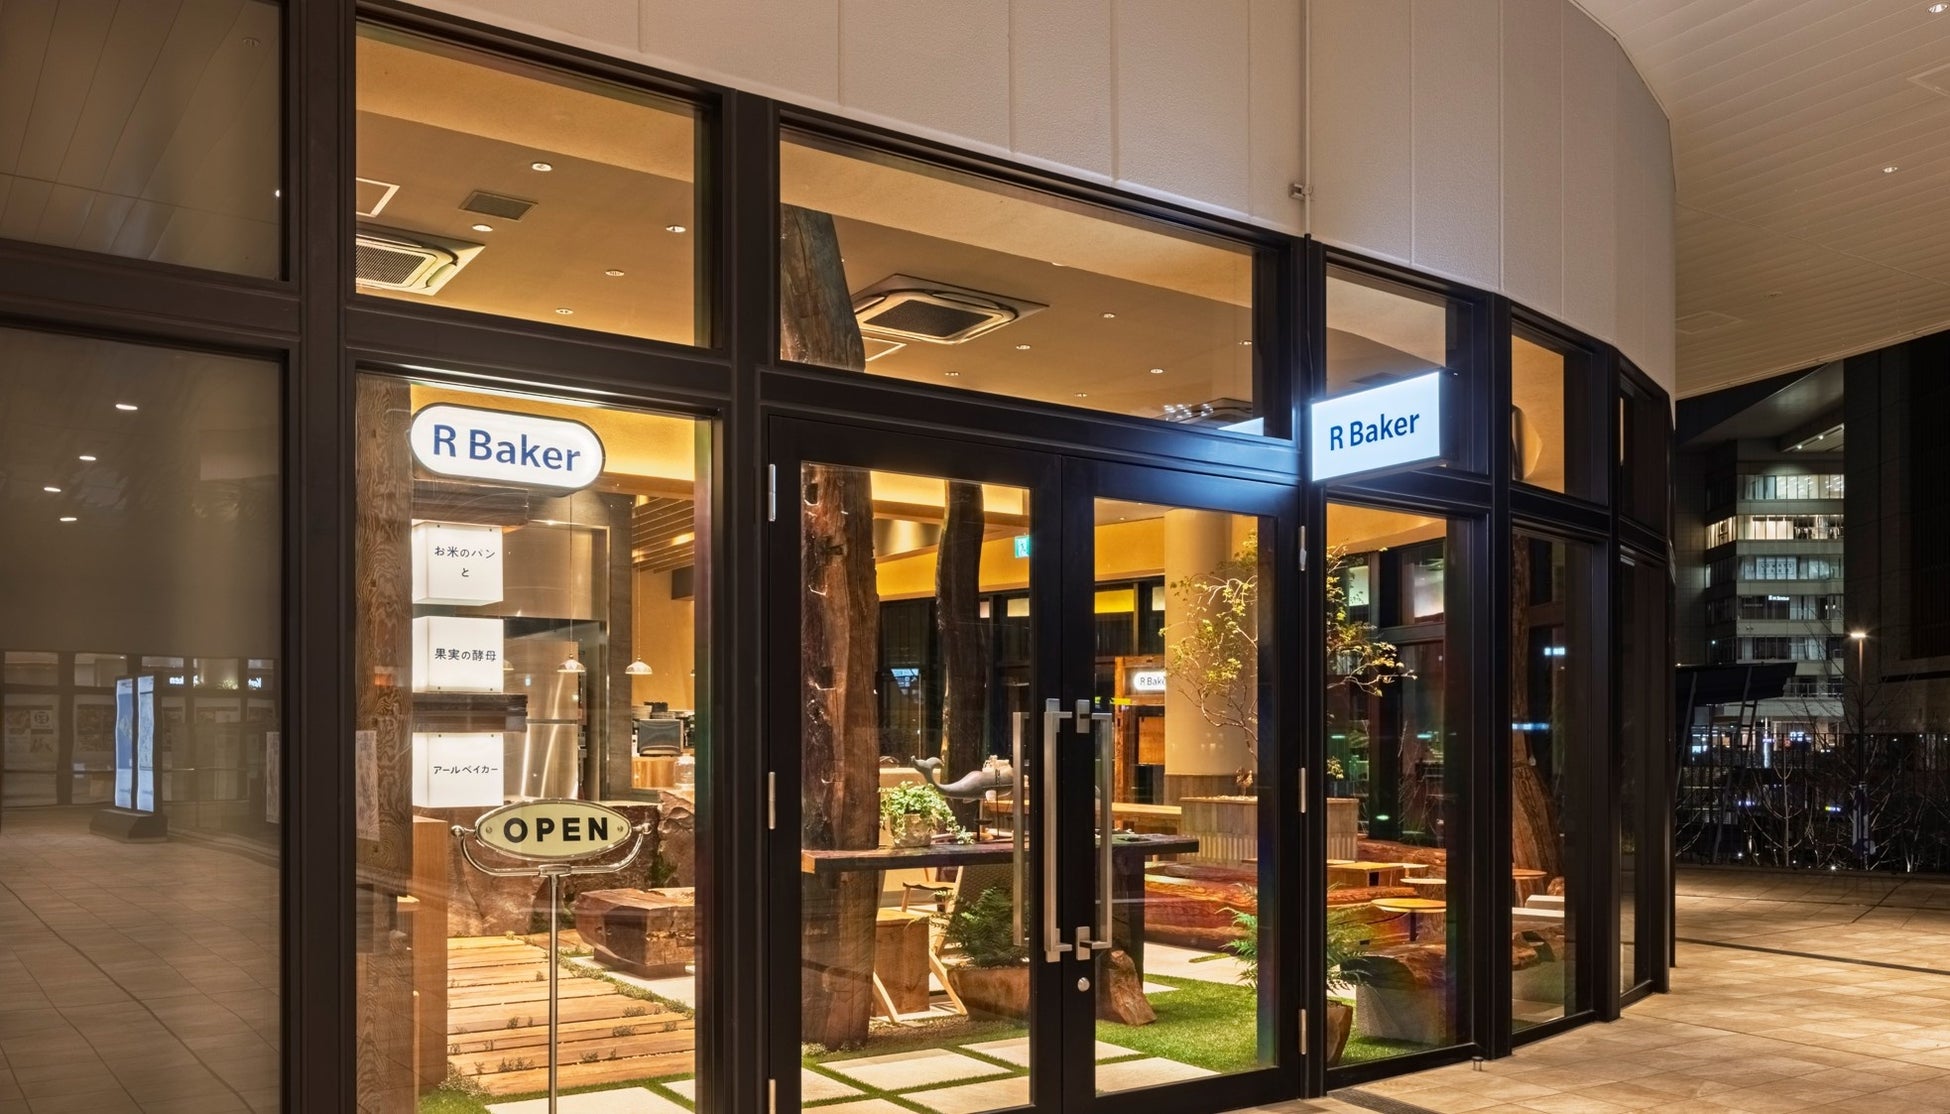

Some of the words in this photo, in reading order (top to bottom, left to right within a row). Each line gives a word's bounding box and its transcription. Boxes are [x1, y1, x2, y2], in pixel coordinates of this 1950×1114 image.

[1330, 425, 1343, 451] R
[1350, 413, 1420, 447] Baker
[433, 424, 456, 457] R
[469, 429, 581, 471] Baker
[461, 567, 470, 578] と
[434, 648, 497, 661] 果実の酵母
[1140, 676, 1146, 686] R
[433, 765, 499, 775] アールベイカー
[503, 817, 608, 843] OPEN
